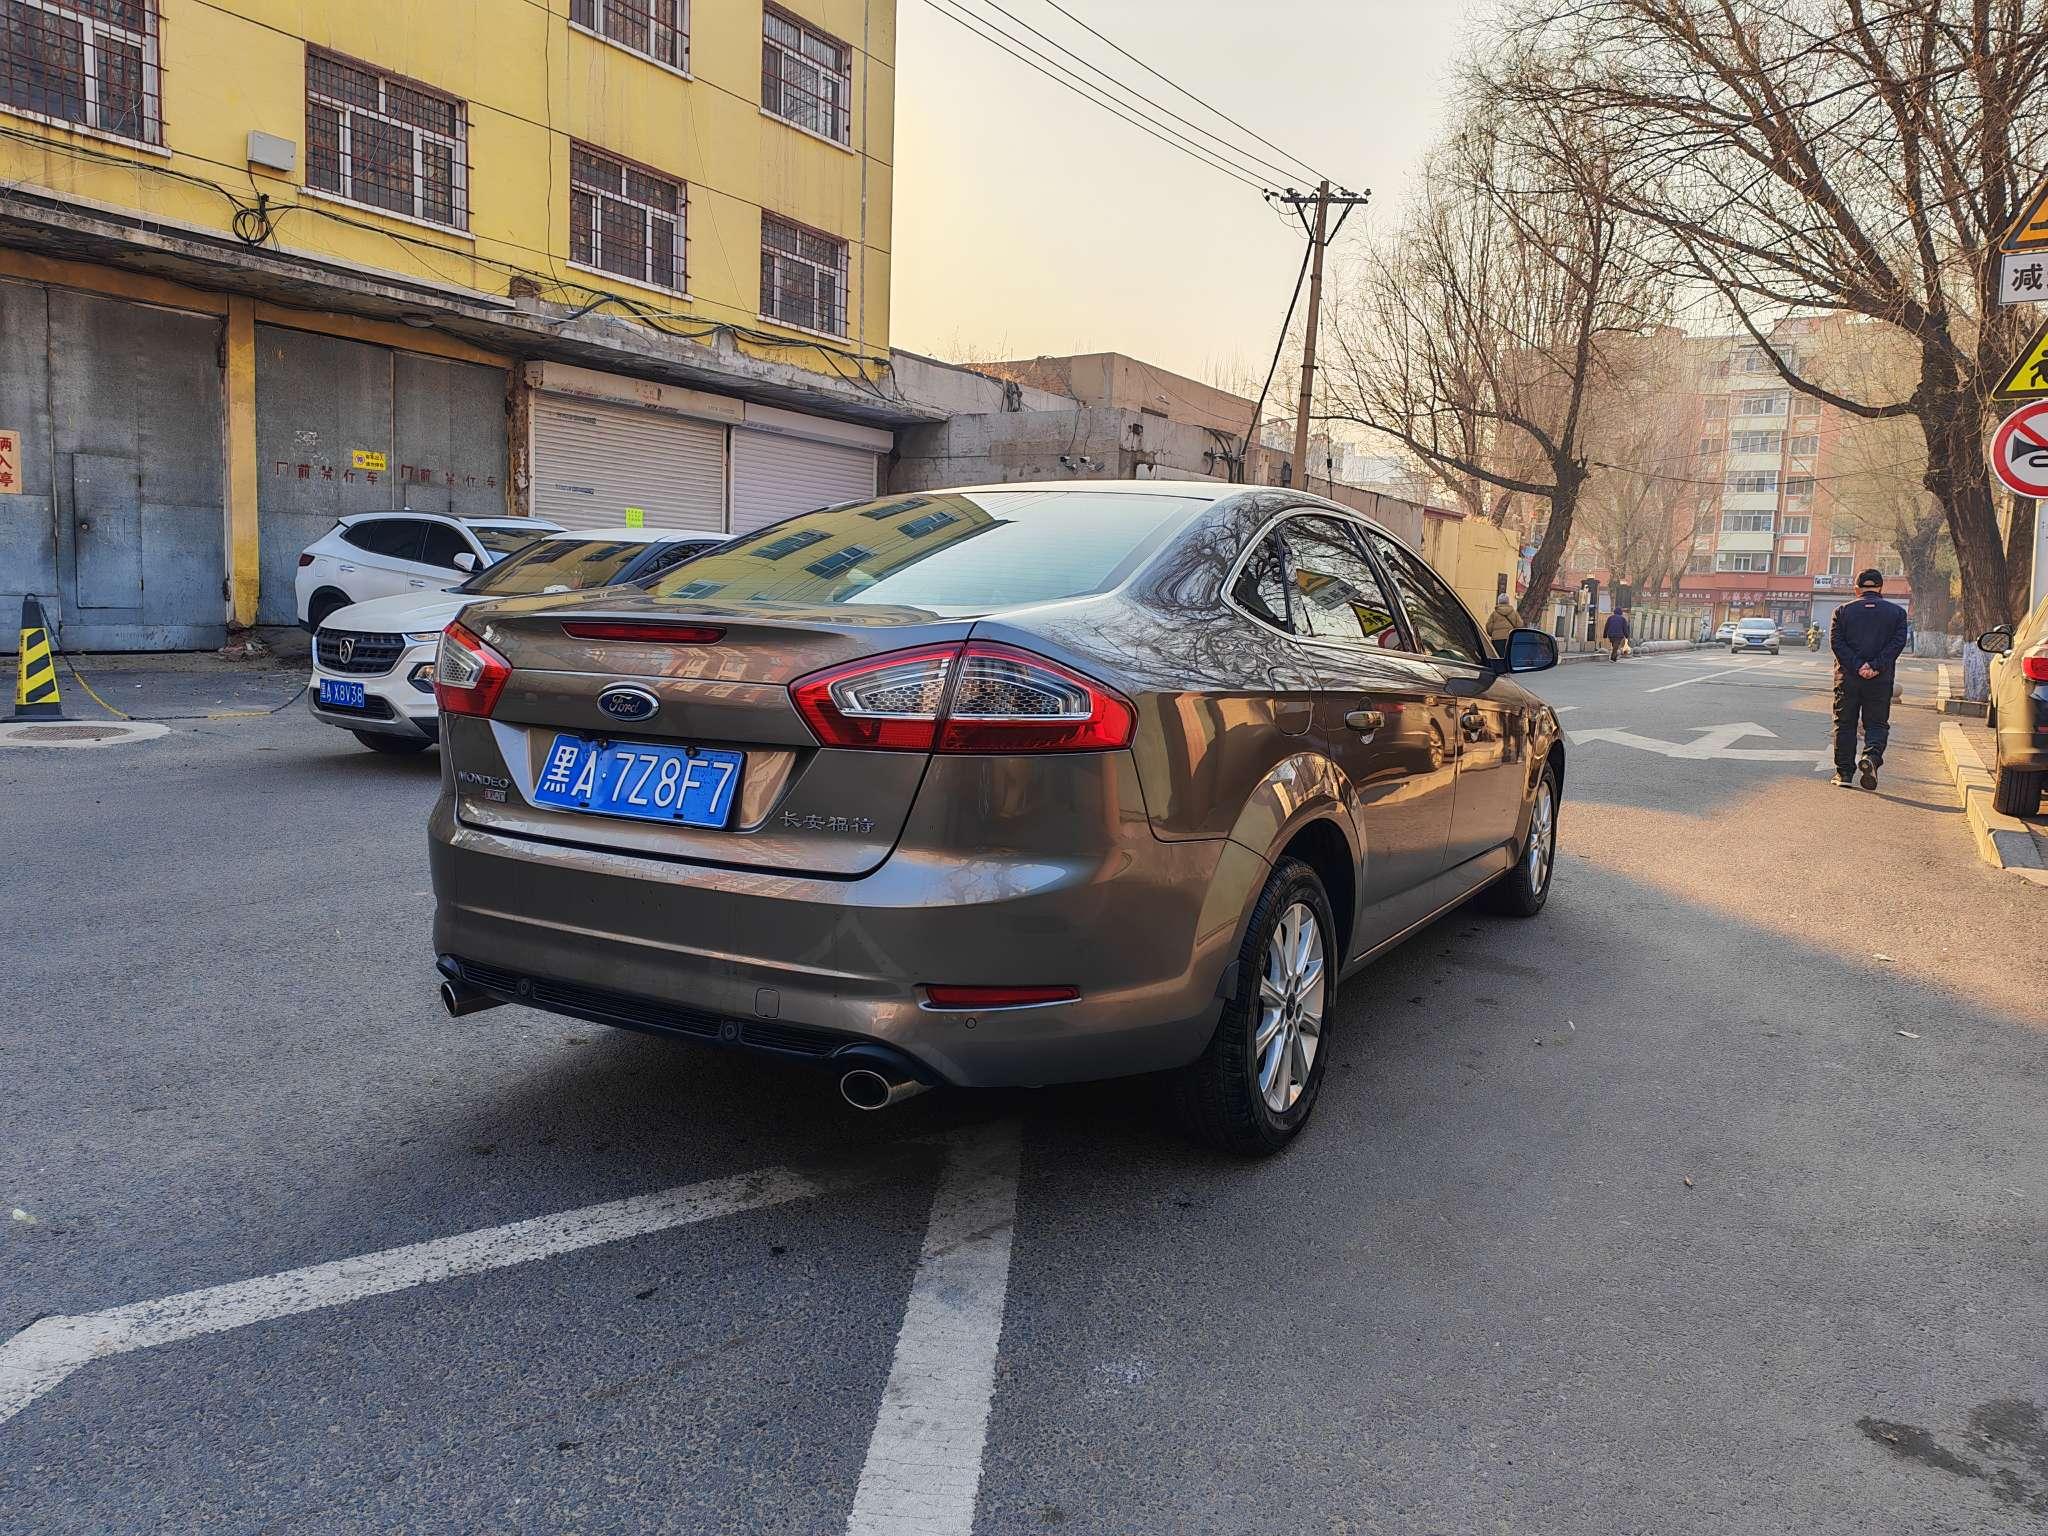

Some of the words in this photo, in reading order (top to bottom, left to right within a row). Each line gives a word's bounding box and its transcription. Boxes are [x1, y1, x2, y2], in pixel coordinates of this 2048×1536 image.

[2011, 263, 2048, 292] 减
[608, 693, 641, 714] Ford
[459, 771, 510, 789] MONDEO
[779, 810, 876, 834] 长安福特
